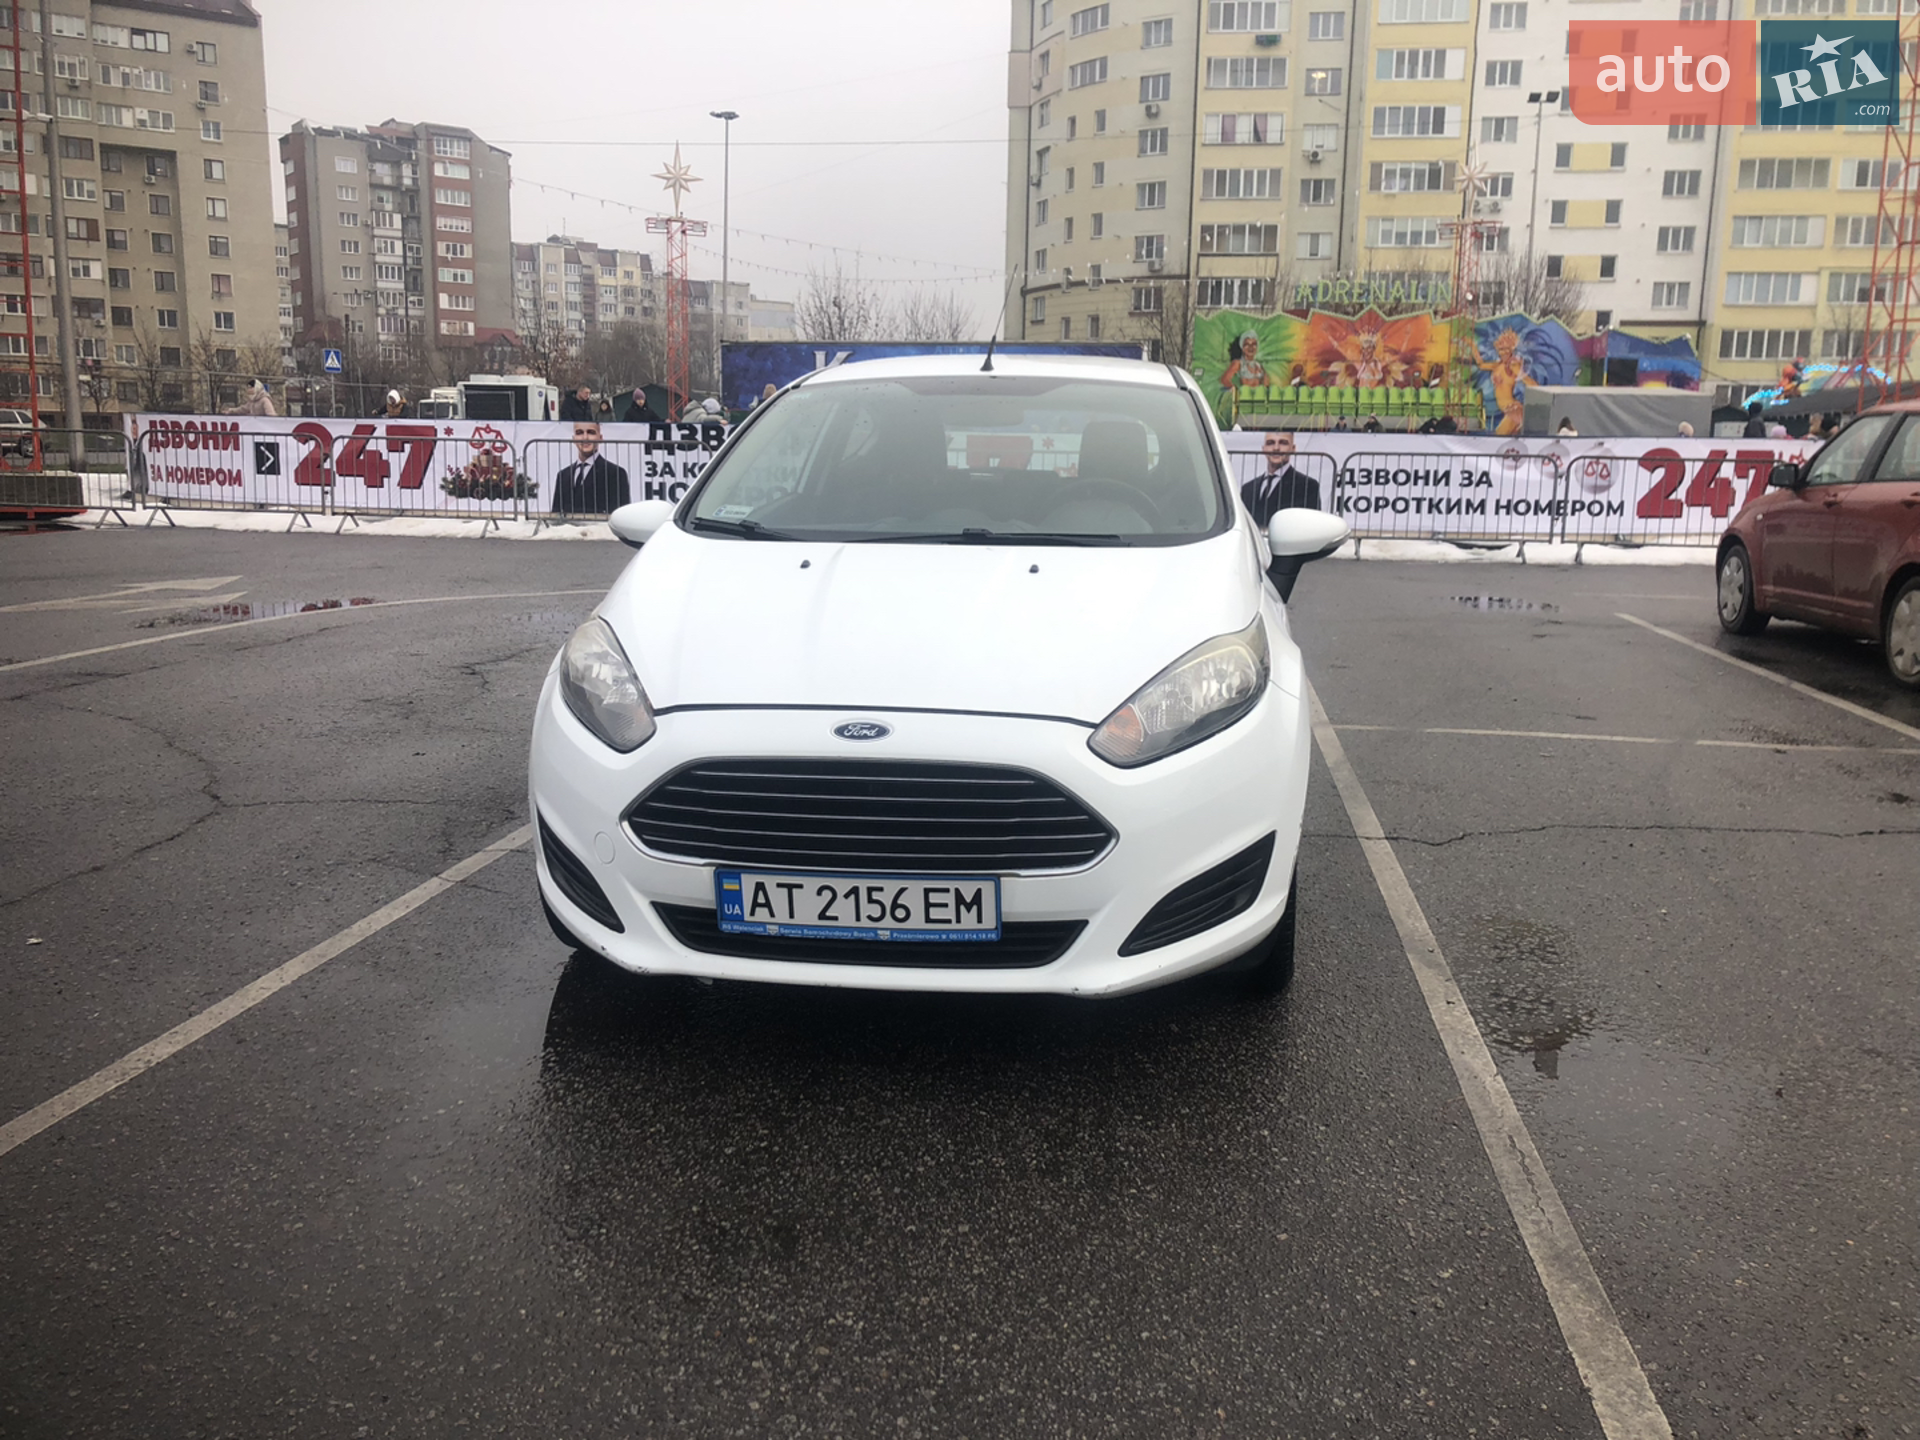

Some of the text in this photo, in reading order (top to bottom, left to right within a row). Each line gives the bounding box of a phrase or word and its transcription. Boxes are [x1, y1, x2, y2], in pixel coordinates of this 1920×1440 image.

[1296, 279, 1452, 303] ADRENALIN
[148, 419, 241, 453] ДЗВОНИ
[644, 423, 740, 456] ДЗВ
[150, 464, 243, 487] ЗА НОМЕРОМ
[644, 461, 676, 478] ЗА
[1336, 467, 1493, 488] ДЗВОНИ ЗА
[1336, 495, 1625, 517] КОРОТКИМ НОМЕРОМ
[843, 723, 880, 737] Ford
[724, 903, 742, 916] UA
[749, 881, 983, 924] AT 2156 EM
